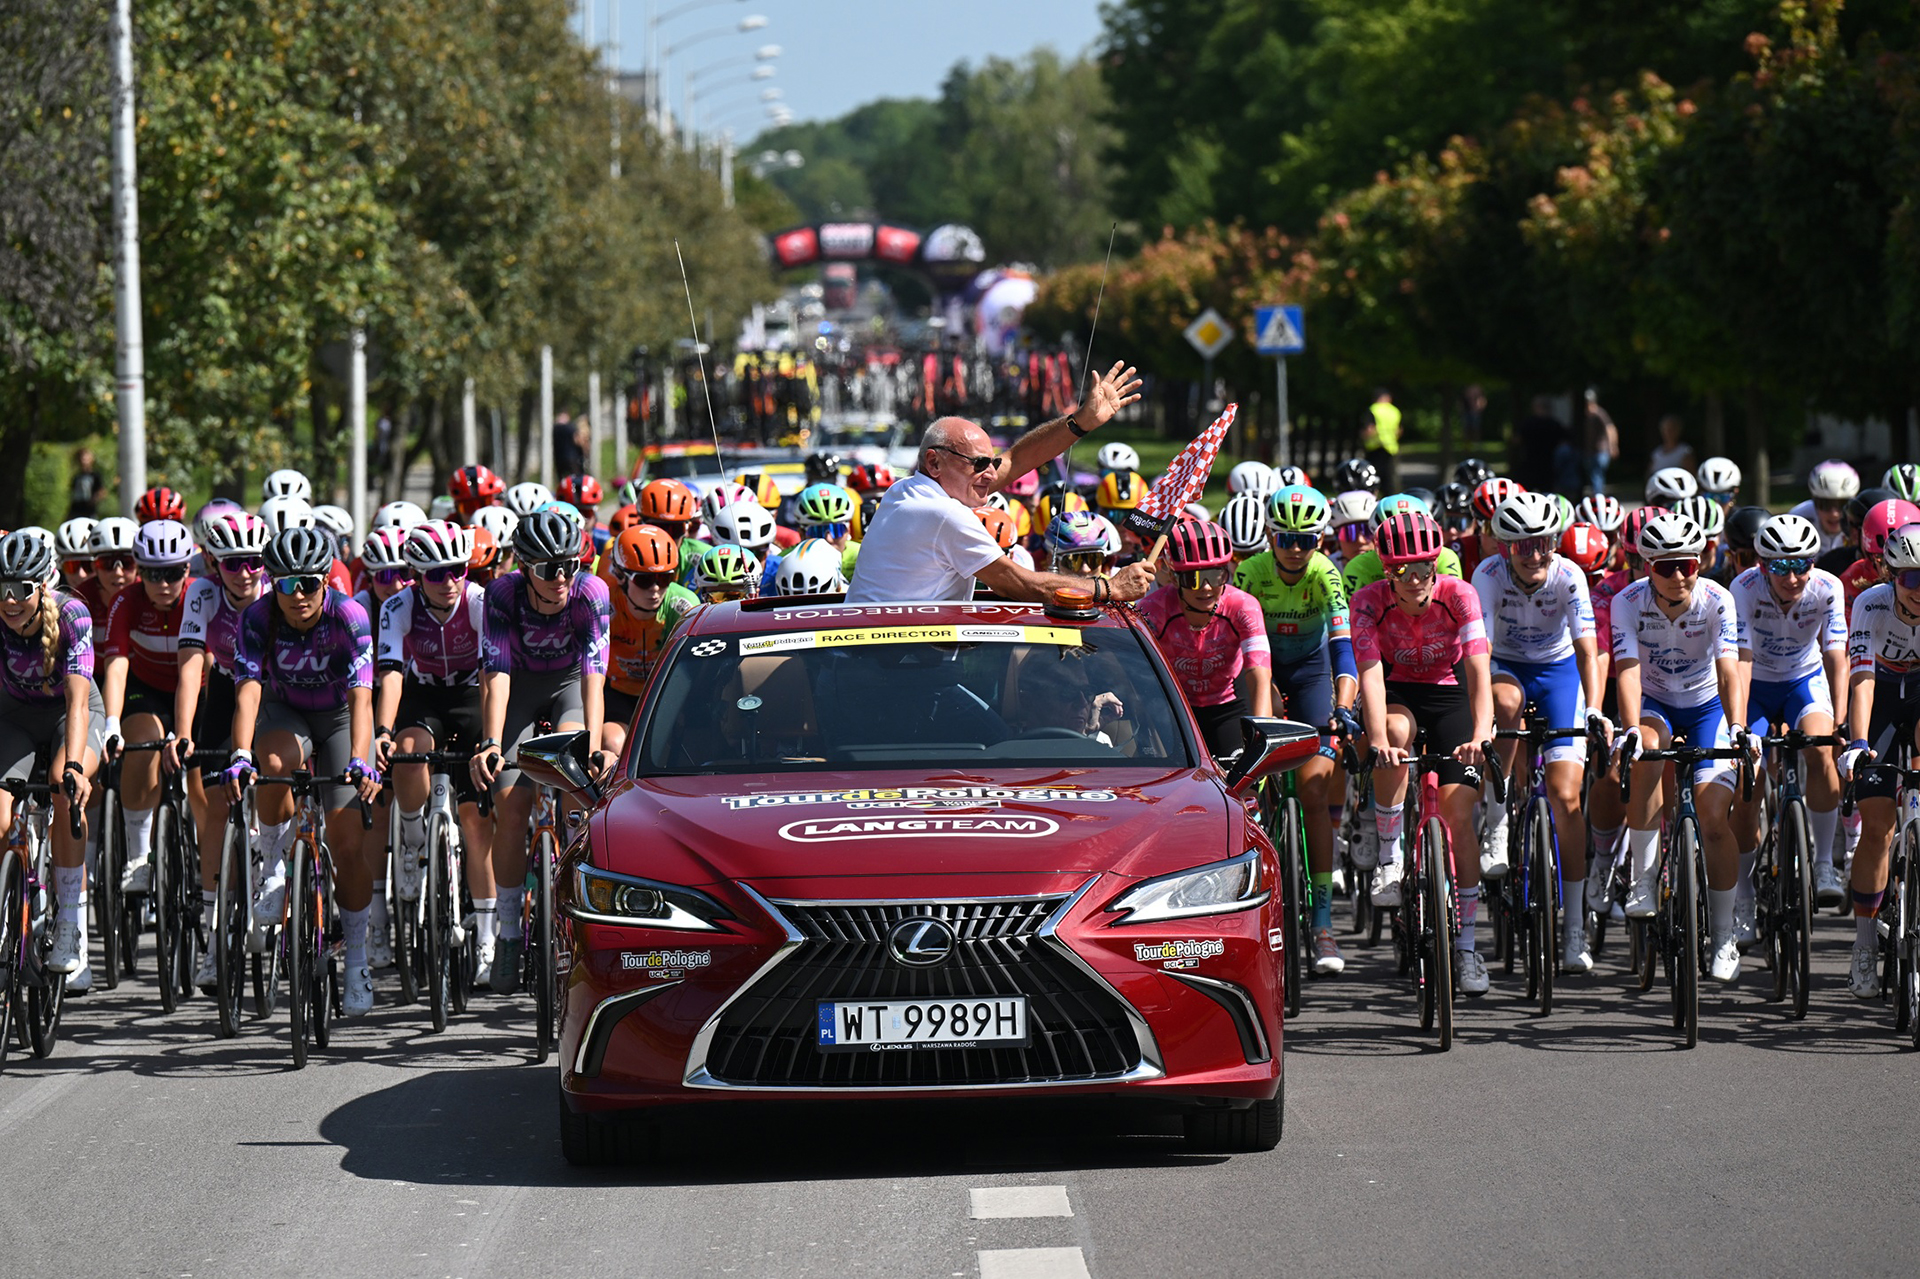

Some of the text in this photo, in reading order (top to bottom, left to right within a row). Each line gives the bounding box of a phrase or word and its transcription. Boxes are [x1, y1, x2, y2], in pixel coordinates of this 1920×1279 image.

[774, 606, 1045, 621] RACE DIRECTOR
[821, 632, 865, 643] RACE
[870, 630, 952, 640] DIRECTOR
[277, 649, 330, 671] Liv
[1464, 765, 1481, 784] Rap
[724, 787, 1117, 809] TourdePologne
[803, 819, 1037, 836] LANGTEAM
[1376, 815, 1400, 833] EF
[1134, 940, 1224, 961] TourdePologne
[621, 950, 711, 970] TourdePologne
[1164, 961, 1178, 969] UCI
[821, 1001, 1018, 1041] PL WT 9989H
[881, 1043, 913, 1051] LEXUS
